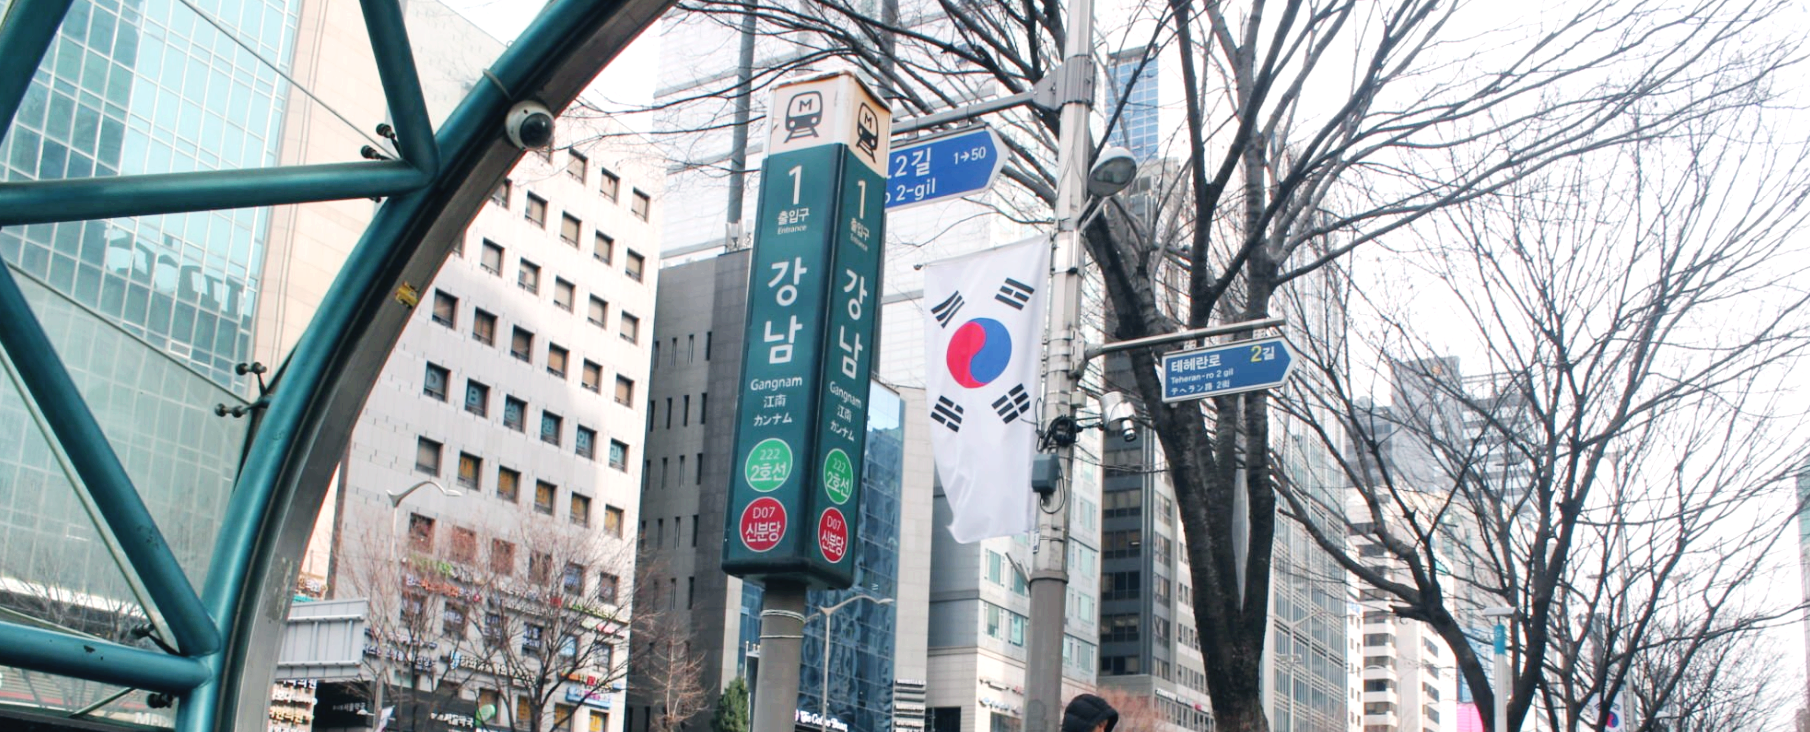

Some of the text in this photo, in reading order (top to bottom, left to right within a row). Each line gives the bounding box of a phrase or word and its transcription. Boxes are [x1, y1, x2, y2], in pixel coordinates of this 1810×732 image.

[799, 98, 813, 112] M
[864, 112, 873, 129] M
[788, 165, 802, 205] 1
[896, 177, 935, 202] 2-gil
[858, 180, 866, 219] 1
[778, 207, 809, 226] 출입구
[777, 225, 807, 235] Entrance
[851, 217, 870, 241] 출입구
[764, 256, 807, 364] 강남
[839, 268, 868, 380] 강남
[1171, 345, 1275, 373] 테헤란로 2길
[1217, 370, 1222, 378] 2
[1223, 368, 1234, 378] gil
[750, 377, 803, 392] Gangnam
[763, 394, 786, 408] 江南
[829, 381, 862, 409] Gangnam
[754, 412, 792, 427] カンナム
[837, 405, 852, 424] 江南
[830, 420, 855, 442] カンナム
[759, 449, 780, 460] 222
[750, 464, 787, 482] 2호선
[833, 458, 846, 473] 222
[827, 471, 850, 497] 2호선
[753, 507, 776, 519] D07
[745, 521, 781, 542] 신분당
[827, 516, 841, 530] D07
[821, 532, 844, 556] 신분당
